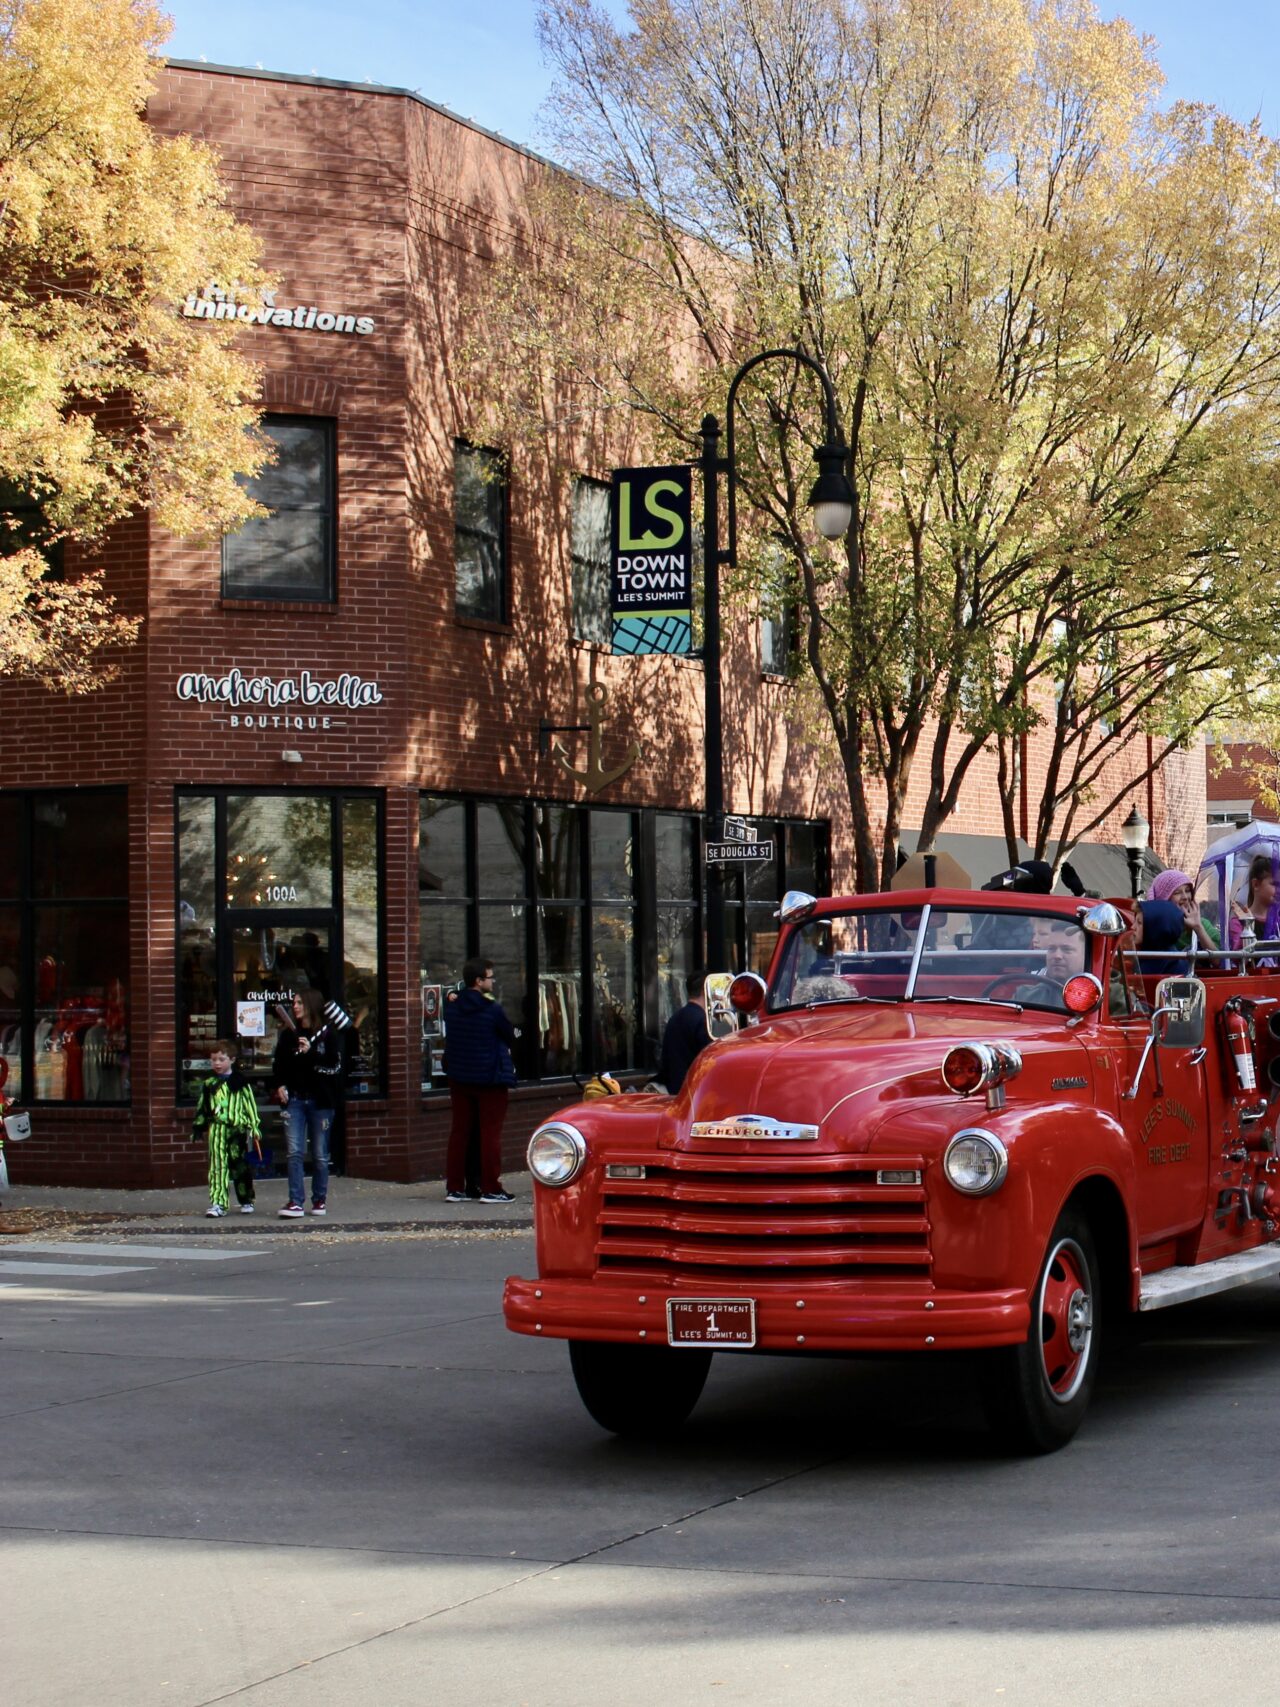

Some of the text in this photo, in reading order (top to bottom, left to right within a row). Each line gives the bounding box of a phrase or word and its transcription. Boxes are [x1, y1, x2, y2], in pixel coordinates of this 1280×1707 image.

[619, 480, 684, 550] LS
[617, 555, 684, 572] DOWN
[617, 572, 685, 590] TOWN
[618, 591, 685, 602] LEE'S SUMMIT
[230, 715, 330, 729] BOUTIQUE
[728, 826, 734, 836] SE
[747, 833, 752, 842] ST
[708, 846, 769, 858] SE DOUGLAS ST
[266, 886, 297, 901] 100A
[1166, 1100, 1197, 1135] SUMMIT
[1149, 1147, 1167, 1164] FIRE
[675, 1304, 749, 1313] FIRE DEPARTMENT
[706, 1312, 719, 1332] 1
[680, 1330, 702, 1339] LEE'S
